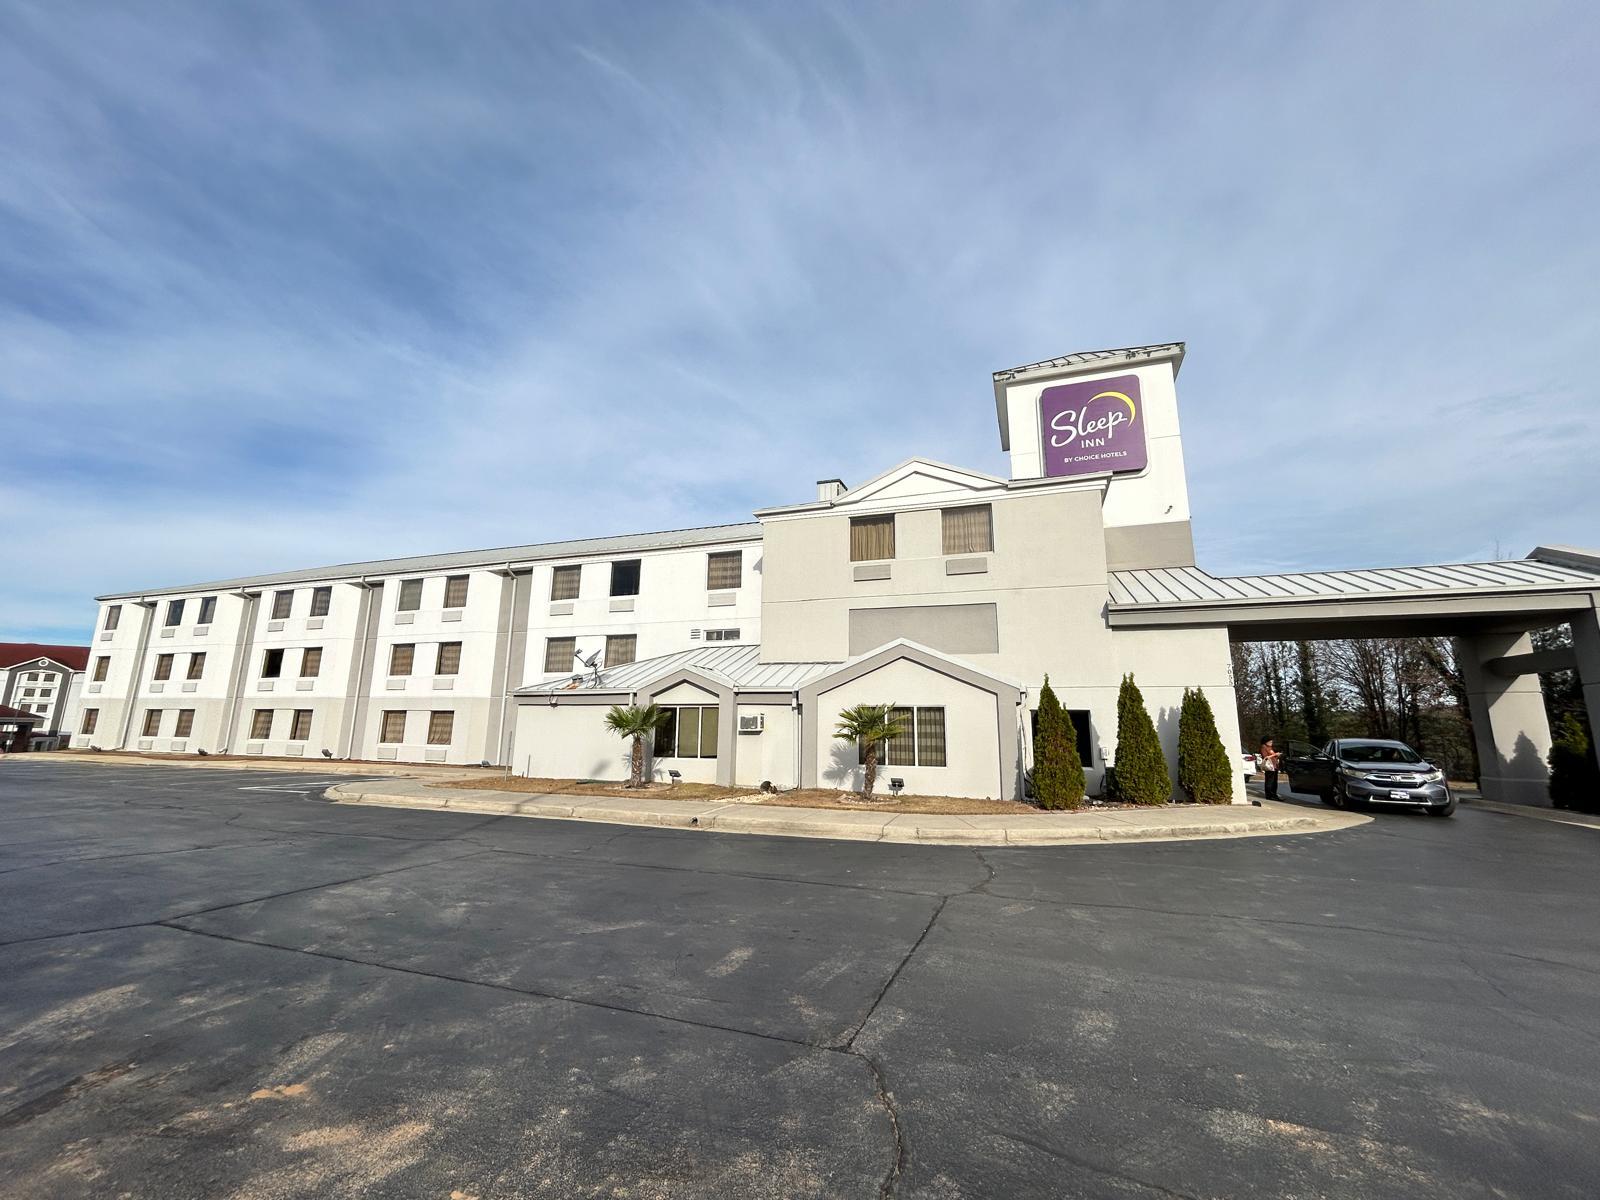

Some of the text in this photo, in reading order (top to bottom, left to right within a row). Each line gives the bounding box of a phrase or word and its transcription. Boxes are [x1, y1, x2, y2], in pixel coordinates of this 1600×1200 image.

[1051, 406, 1128, 447] Sleep
[1081, 438, 1105, 448] INN
[1074, 454, 1100, 462] CHOICE
[1100, 450, 1128, 460] HOTELS
